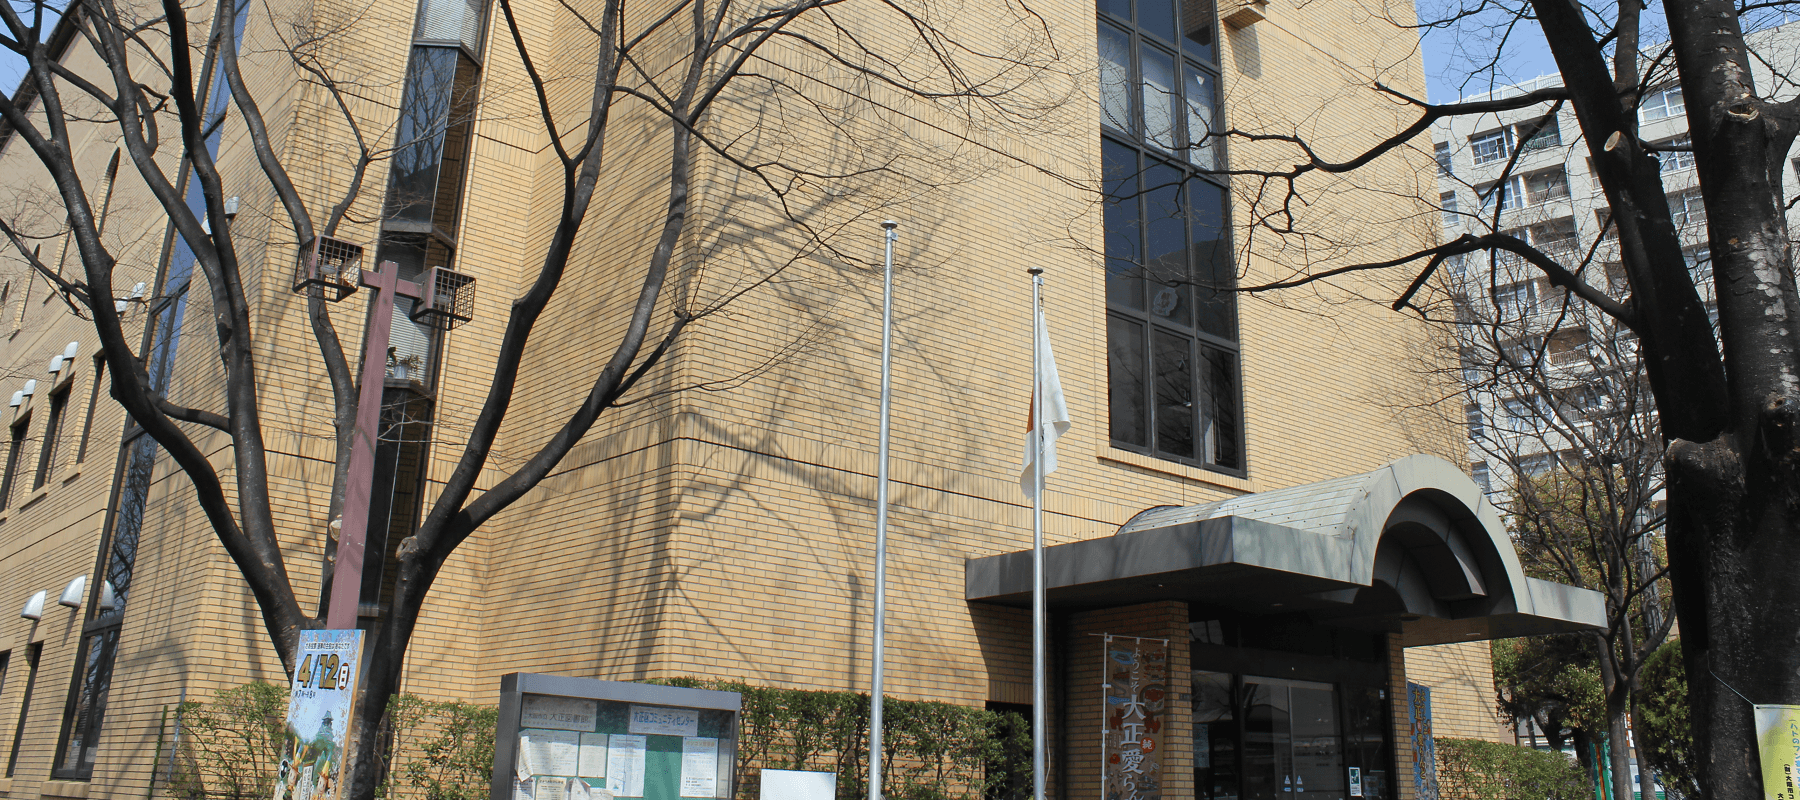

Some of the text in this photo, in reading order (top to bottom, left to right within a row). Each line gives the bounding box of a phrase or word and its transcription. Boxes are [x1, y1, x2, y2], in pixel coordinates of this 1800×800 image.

[297, 653, 339, 689] 4/12
[1130, 647, 1142, 692] ようこそ
[633, 711, 695, 727] 大正区コミュニティセンター
